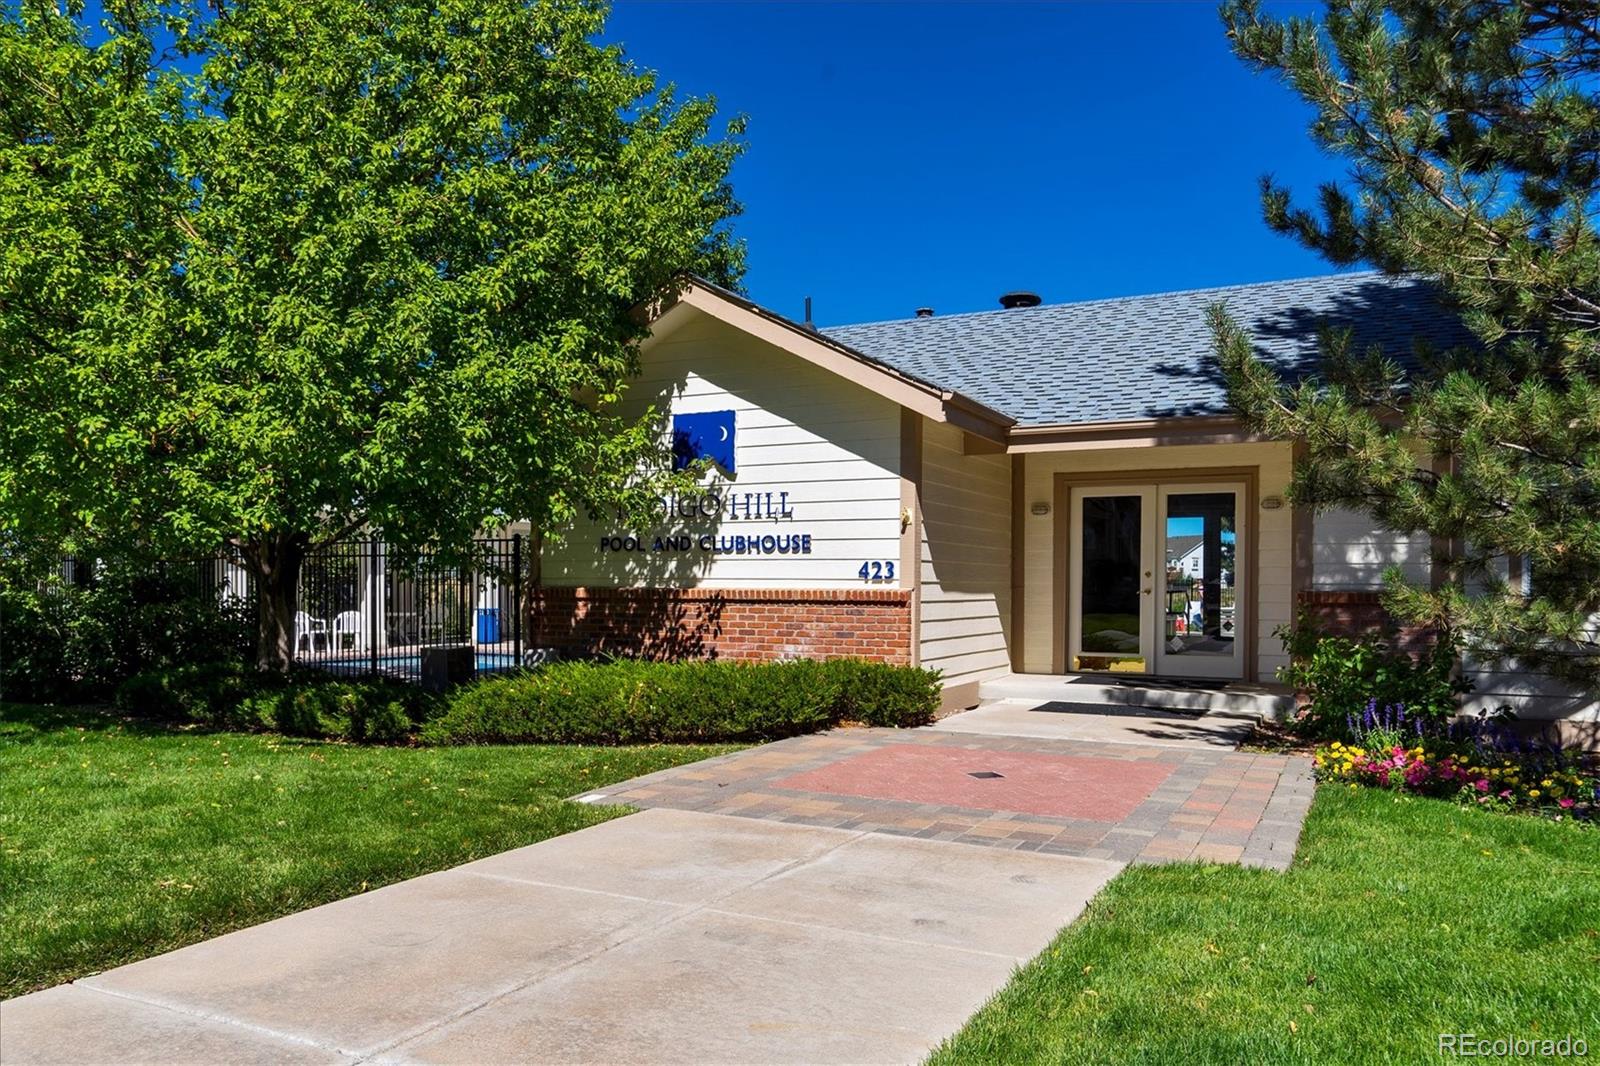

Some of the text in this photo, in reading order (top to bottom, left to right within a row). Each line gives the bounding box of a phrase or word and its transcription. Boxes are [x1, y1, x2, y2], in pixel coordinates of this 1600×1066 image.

[730, 492, 794, 520] HILL
[600, 534, 812, 552] POOL AND CLUBHOUSE
[858, 561, 895, 580] 423
